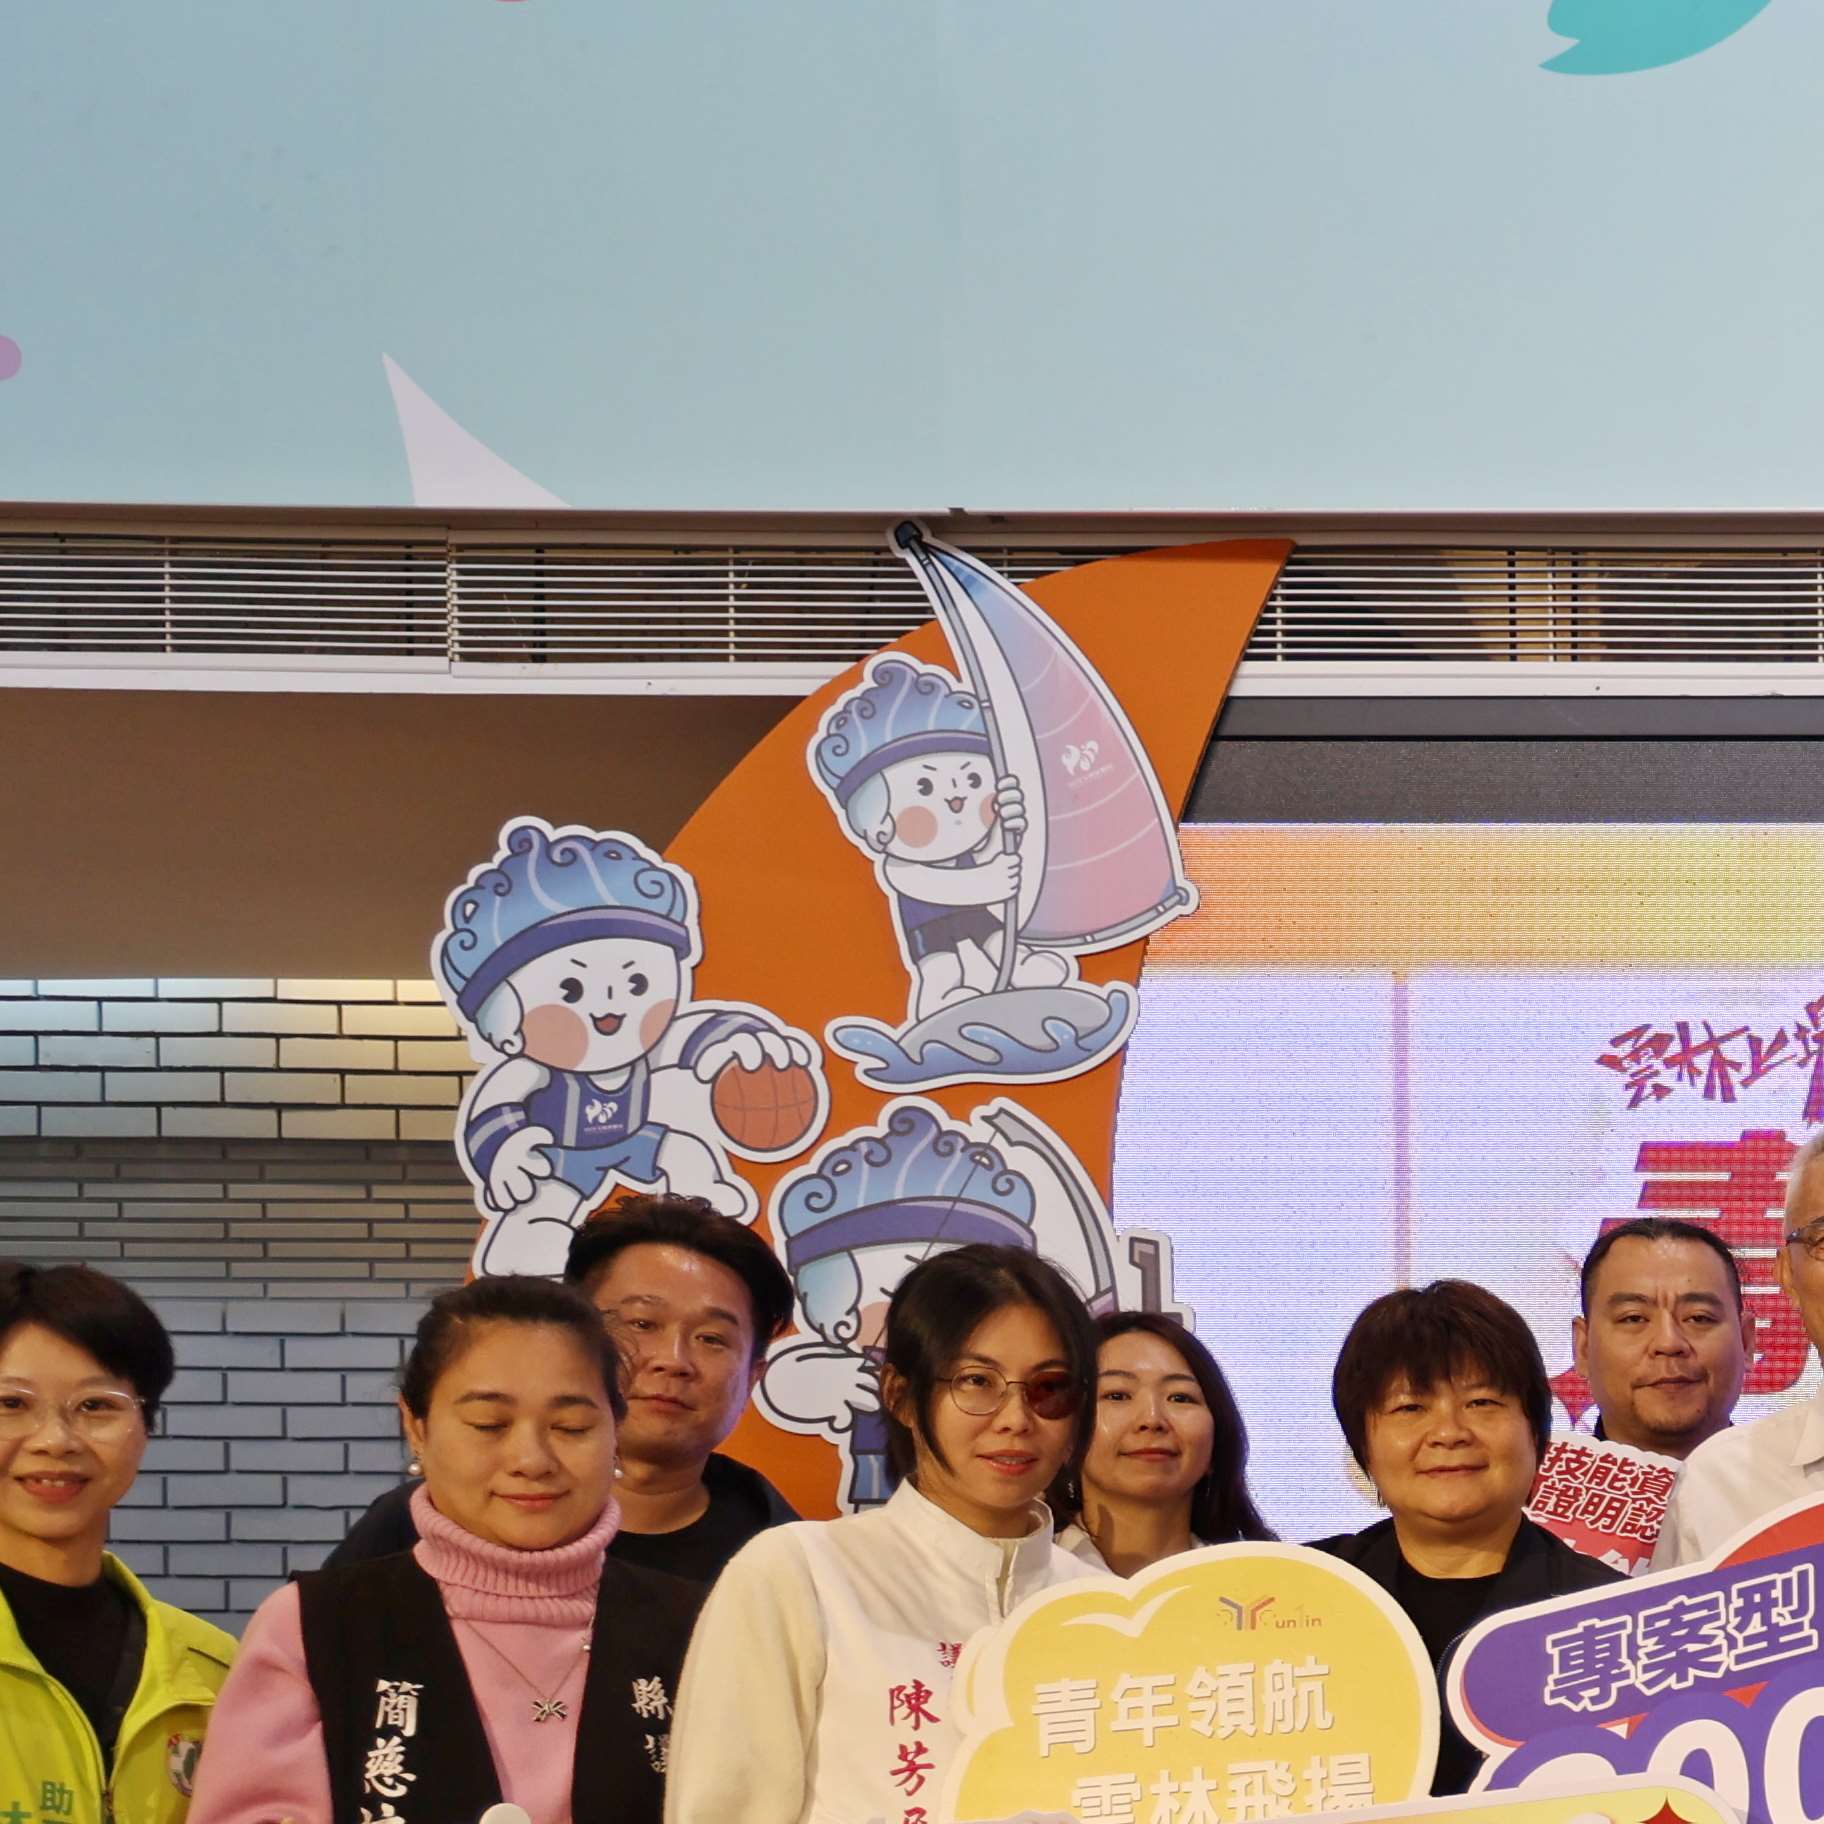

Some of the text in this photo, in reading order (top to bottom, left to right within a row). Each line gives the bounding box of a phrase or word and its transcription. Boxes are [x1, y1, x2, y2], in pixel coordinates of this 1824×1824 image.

[1545, 1555, 1819, 1711] 專案型
[1031, 1656, 1333, 1755] 青年領航
